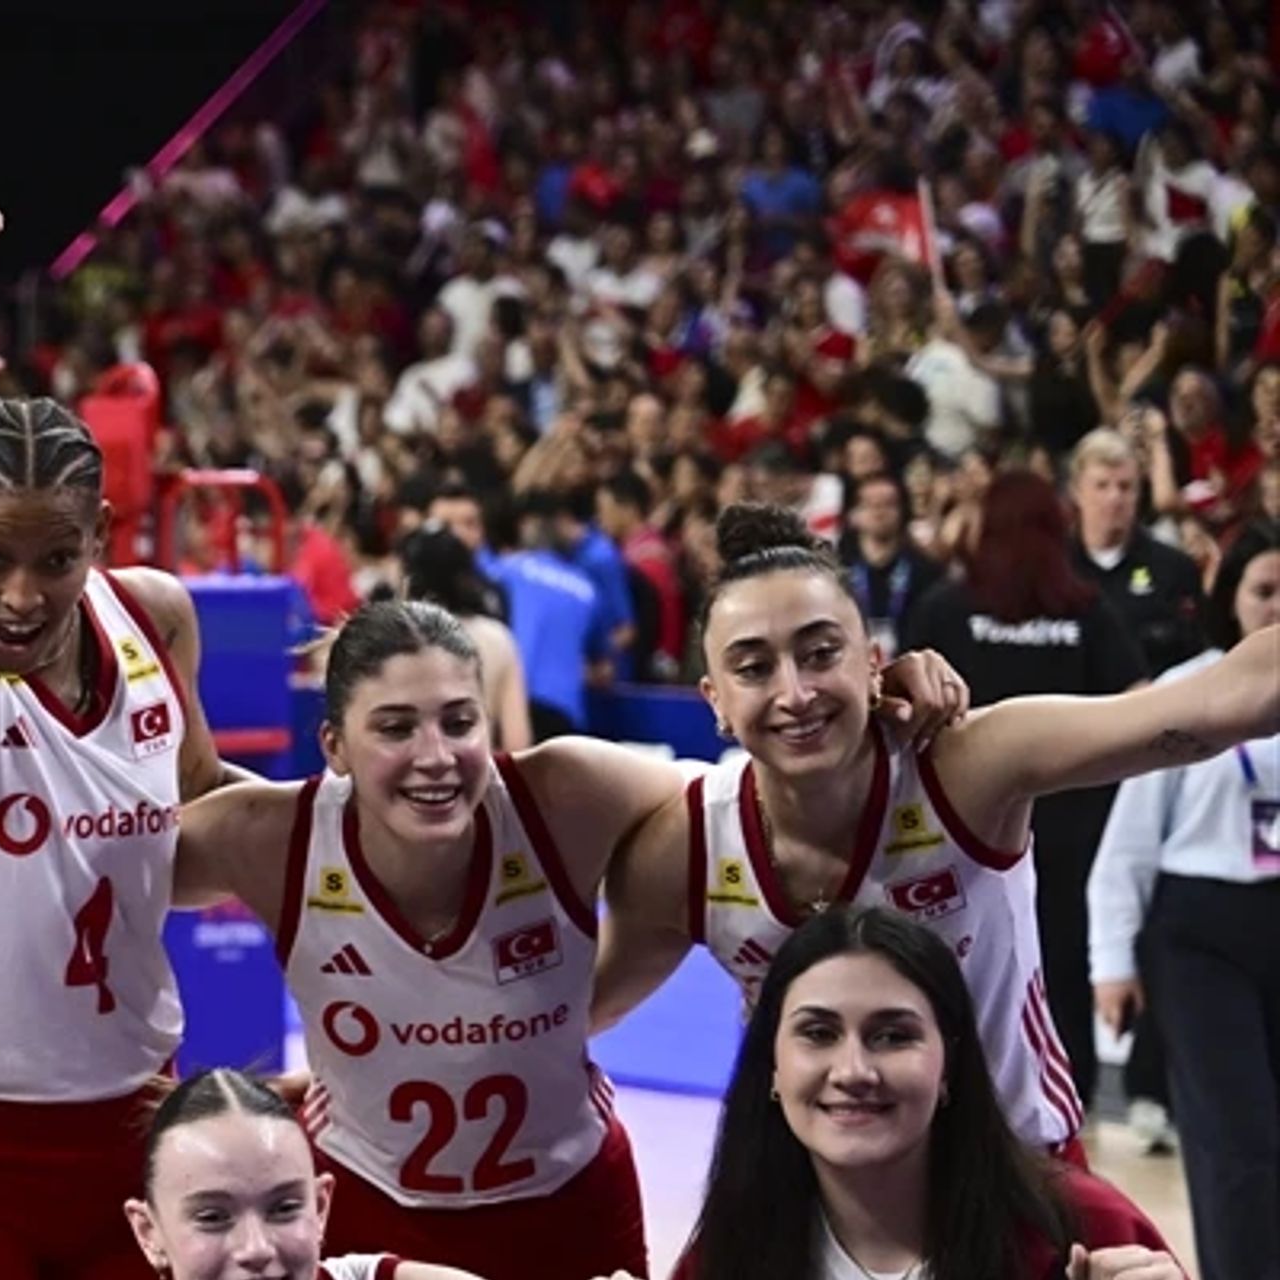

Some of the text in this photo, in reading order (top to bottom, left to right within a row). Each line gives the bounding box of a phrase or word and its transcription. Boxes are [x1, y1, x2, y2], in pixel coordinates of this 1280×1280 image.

[122, 643, 138, 661] S
[900, 808, 919, 830] S
[503, 859, 522, 879] S
[726, 864, 740, 884] S
[325, 872, 344, 892] S
[63, 876, 117, 1015] 4
[390, 1002, 569, 1046] vodafone
[387, 1073, 536, 1195] 22
